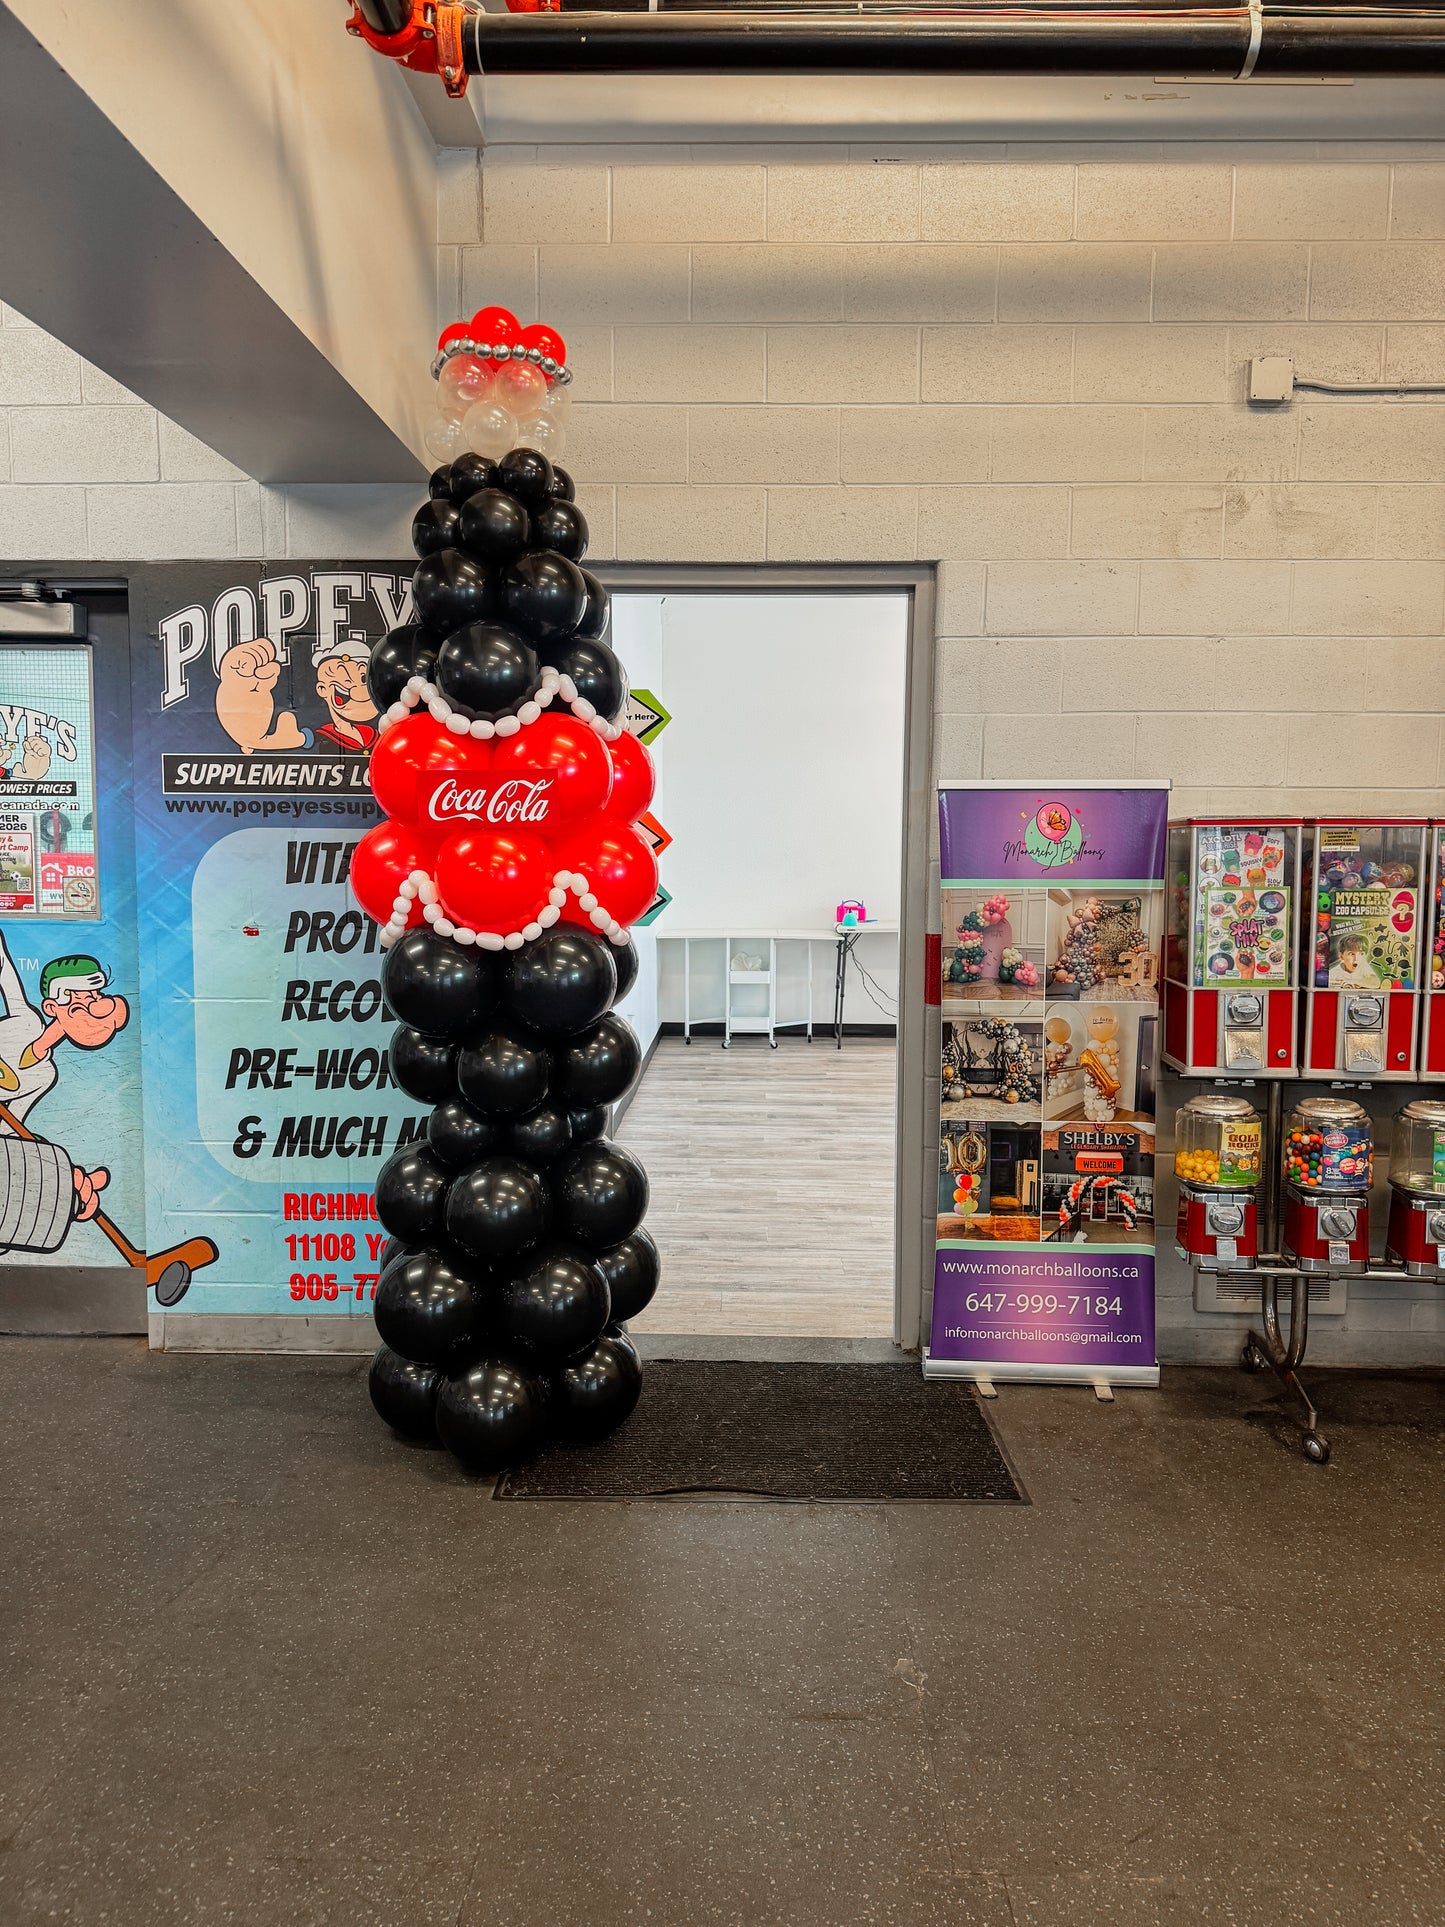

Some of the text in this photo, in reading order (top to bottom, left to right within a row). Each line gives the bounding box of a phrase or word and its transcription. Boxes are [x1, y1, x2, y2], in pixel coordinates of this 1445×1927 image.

[174, 762, 345, 787] SUPPLEMENTS
[36, 783, 73, 794] PRICES
[428, 778, 554, 823] Coca Cola
[0, 823, 27, 831] 2026
[8, 844, 29, 852] Camp
[1003, 840, 1106, 864] Monarch Balloons
[1335, 891, 1390, 905] MYSTERY
[1335, 906, 1390, 915] EGG CAPSULES
[284, 910, 389, 954] PROT
[1229, 919, 1265, 936] SPLAT
[1235, 933, 1259, 948] MIX
[18, 958, 39, 970] TM
[281, 979, 397, 1023] RECO
[232, 1115, 267, 1158] &
[272, 1115, 388, 1158] MUCH
[1063, 1131, 1135, 1146] SHELBY'S
[1228, 1134, 1259, 1142] GOLD
[1083, 1160, 1116, 1169] WELCOME
[284, 1233, 356, 1261] 11108
[943, 1262, 1139, 1279] www.monarchballoons.ca
[289, 1273, 382, 1301] 905-77
[965, 1292, 1122, 1316] 647-999-7184
[945, 1327, 1142, 1345] infomonarchballoons@gmail.com
